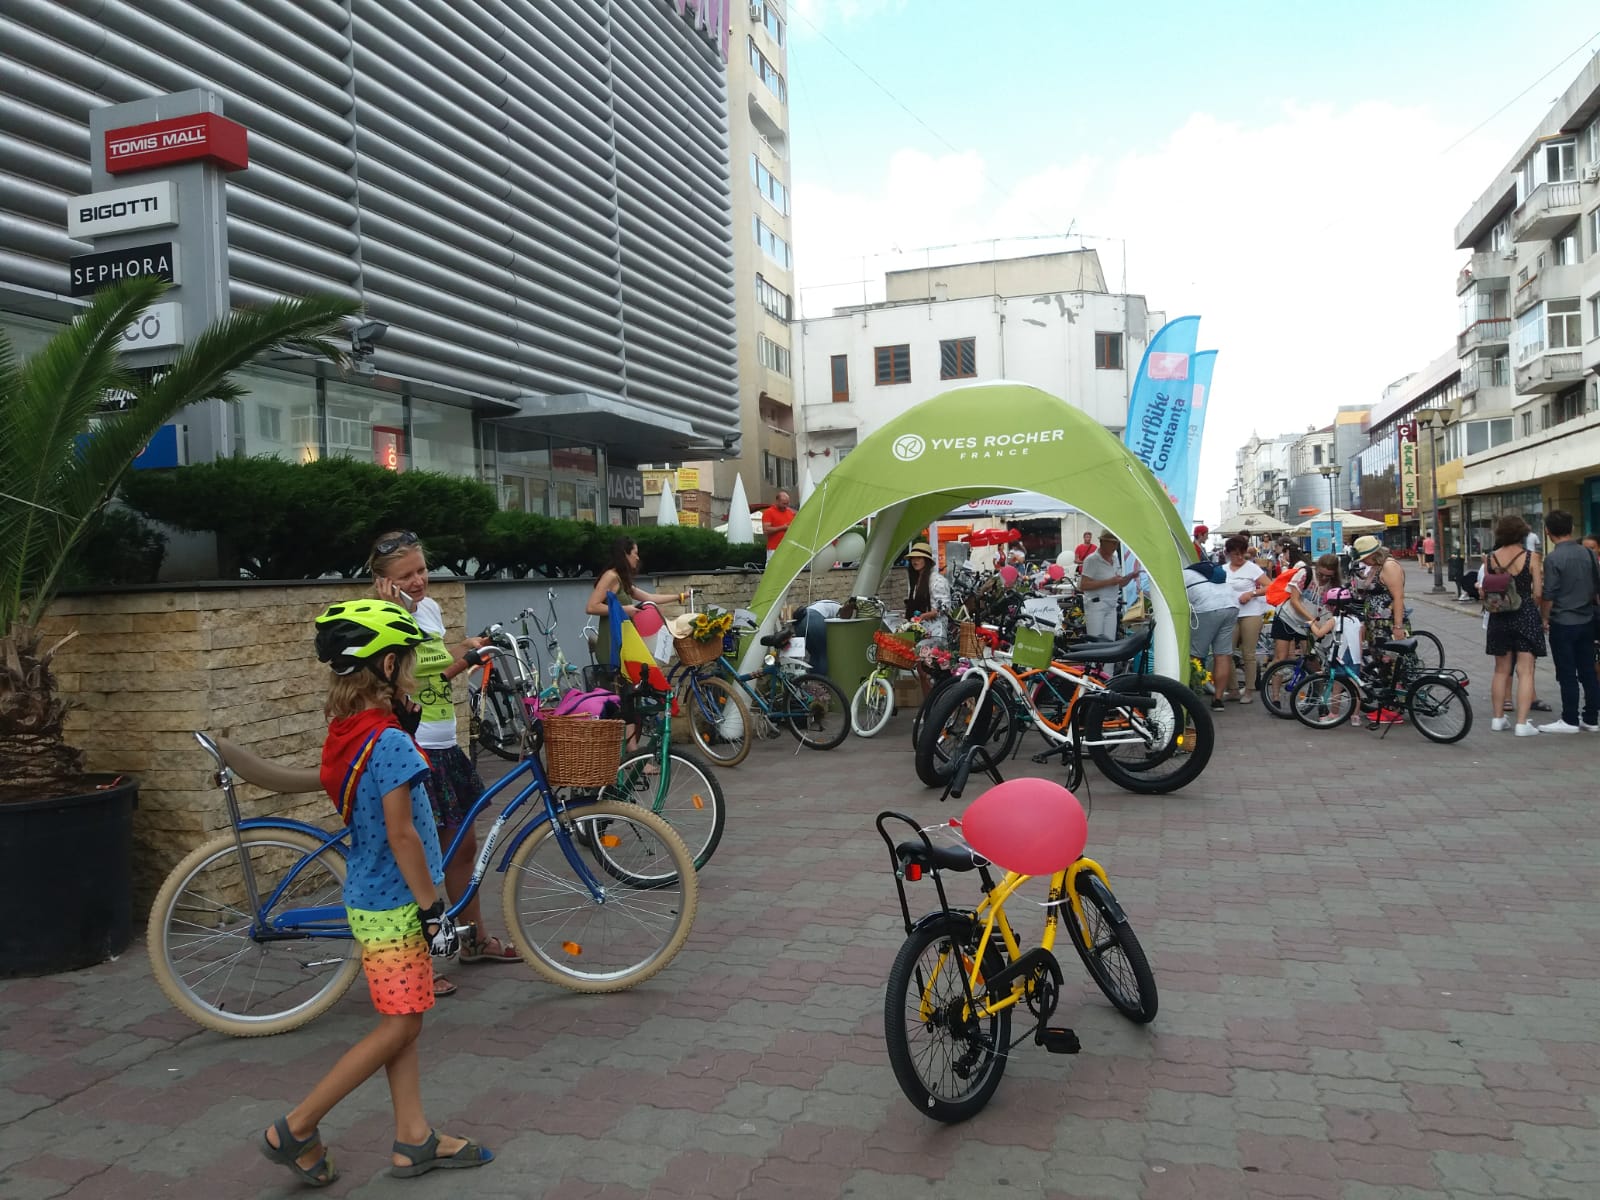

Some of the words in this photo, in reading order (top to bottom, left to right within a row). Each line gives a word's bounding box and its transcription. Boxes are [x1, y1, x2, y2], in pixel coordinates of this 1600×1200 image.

[109, 137, 158, 155] TOMIS
[163, 130, 206, 146] MALL
[80, 197, 158, 223] BIGOTTI
[74, 256, 169, 285] SEPHORA
[931, 437, 977, 450] YVES
[984, 429, 1065, 448] ROCHER
[1153, 398, 1187, 472] Constanța
[960, 447, 1029, 460] FRANCE
